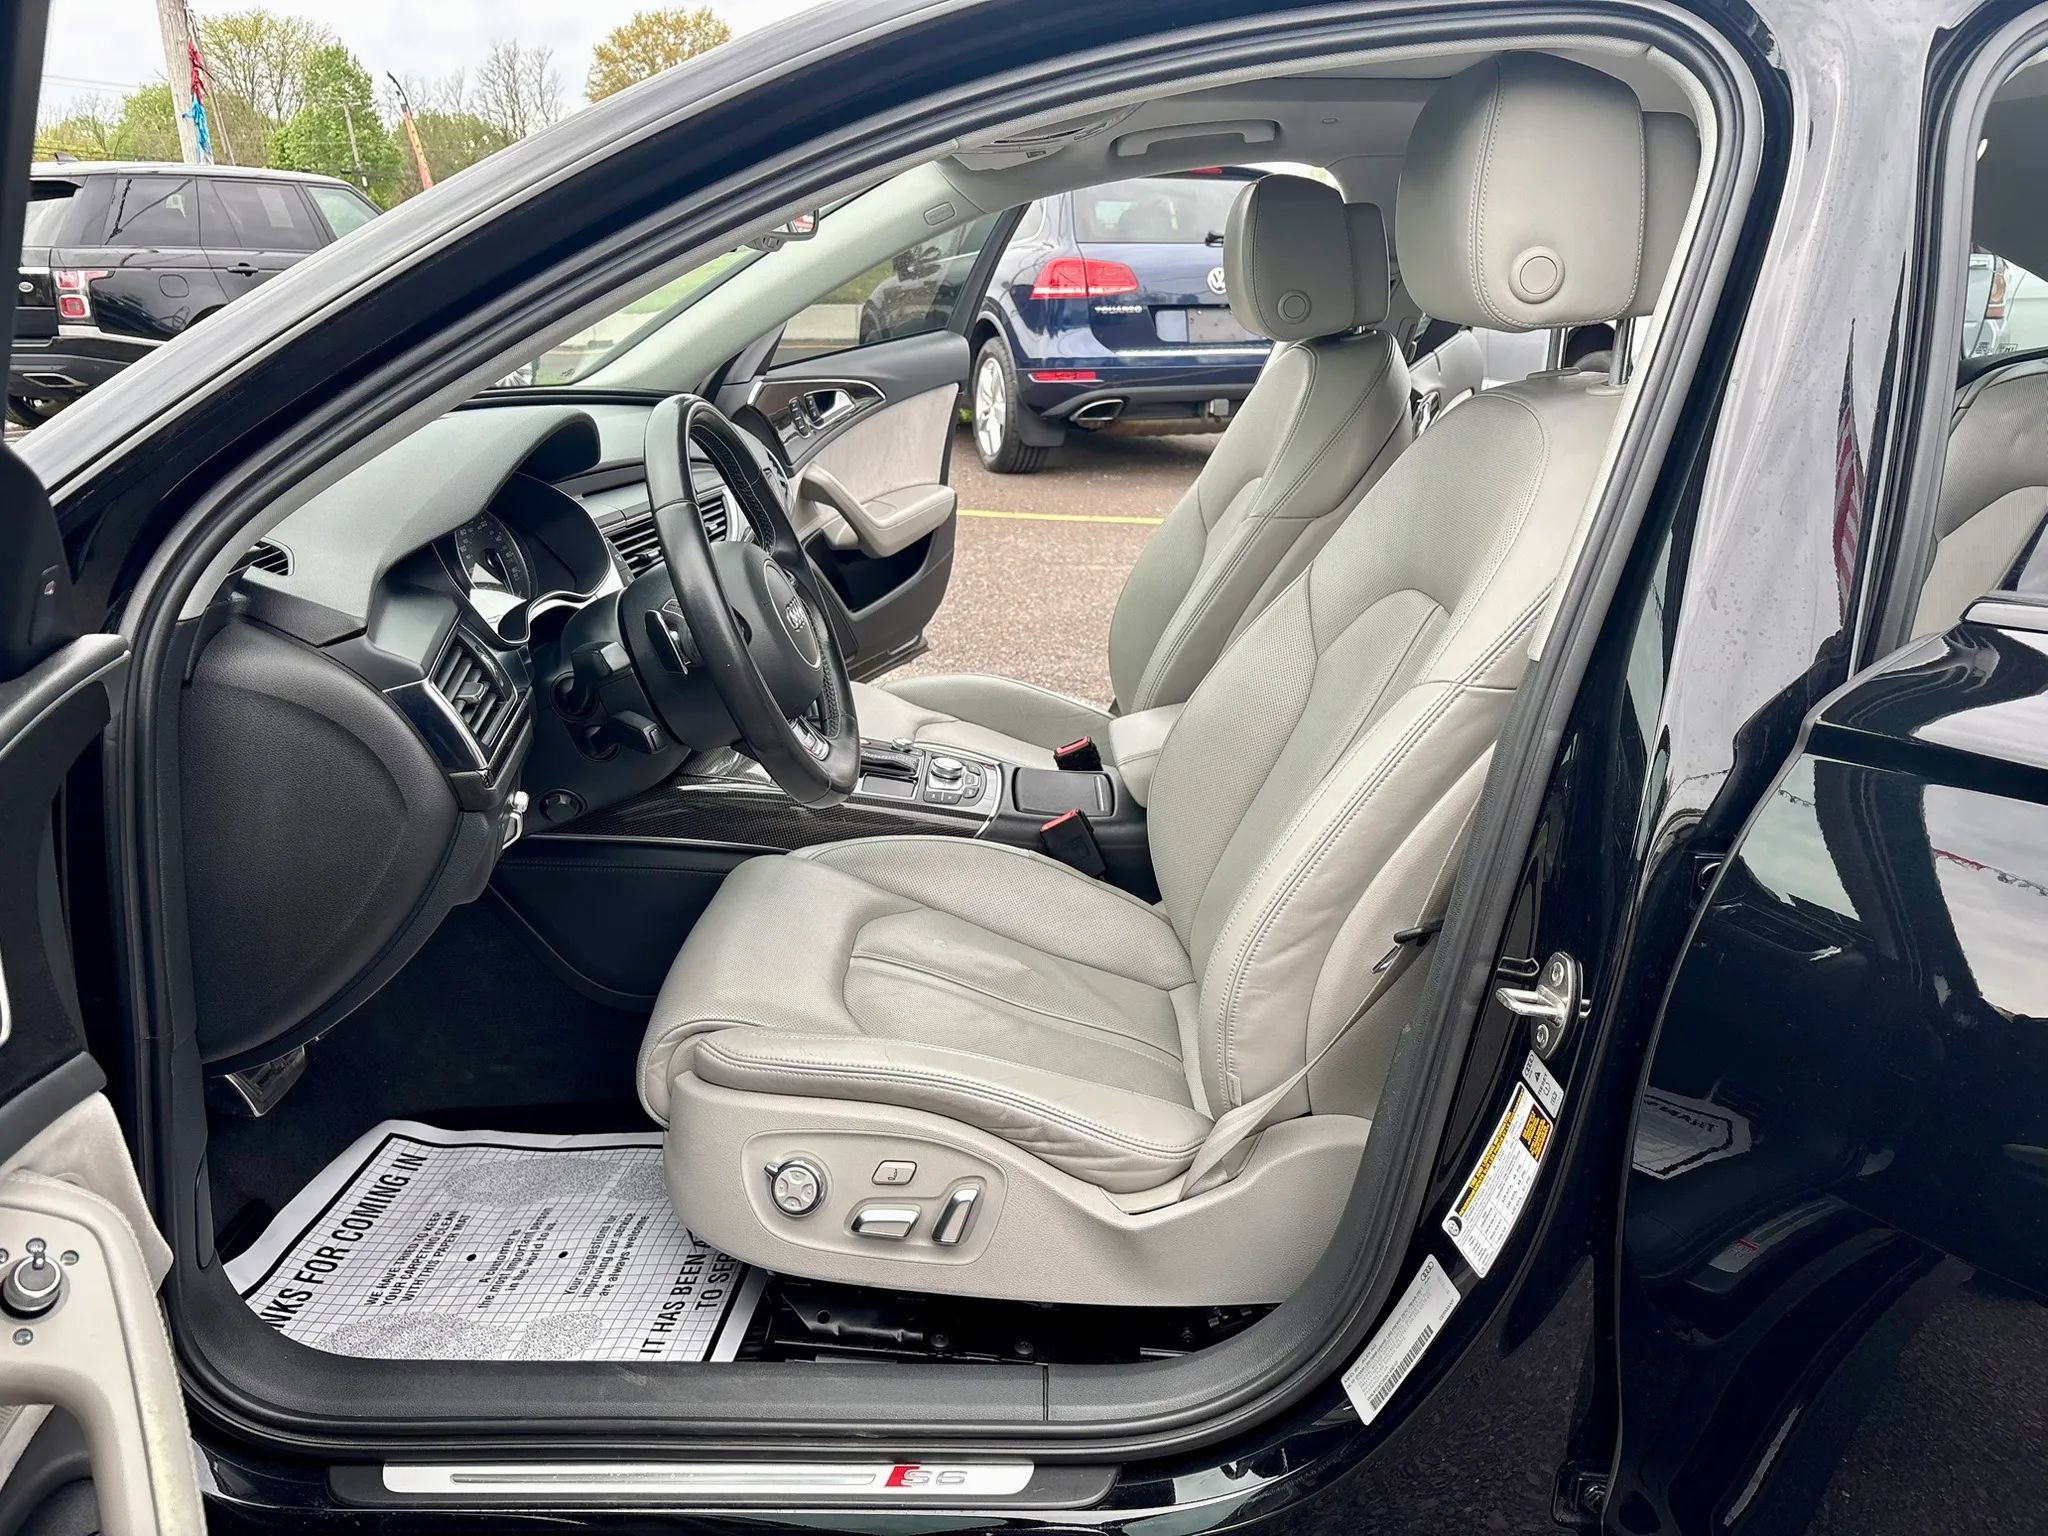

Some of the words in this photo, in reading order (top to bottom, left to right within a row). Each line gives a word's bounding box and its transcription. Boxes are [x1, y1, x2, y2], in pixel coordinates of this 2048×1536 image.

[293, 1246, 350, 1284] FOR
[331, 1173, 410, 1241] COMING
[391, 1152, 428, 1172] IN
[364, 1291, 384, 1305] WE
[376, 1267, 400, 1289] HAVE
[393, 1243, 419, 1266] TRIED
[413, 1233, 428, 1242] TO
[423, 1212, 442, 1232] KEEP
[380, 1282, 406, 1306] YOUR
[400, 1236, 441, 1280] CARPETING
[434, 1210, 459, 1235] CLEAN
[400, 1279, 425, 1302] WITH
[418, 1259, 440, 1277] THIS
[433, 1233, 459, 1257] PAPER
[452, 1214, 471, 1231] MAT
[486, 1238, 515, 1276] customer
[505, 1282, 519, 1291] in
[524, 1243, 544, 1267] world
[537, 1232, 549, 1241] to
[563, 1277, 583, 1295] Your
[578, 1225, 611, 1275] suggestions
[606, 1240, 619, 1255] our
[477, 1295, 494, 1309] the
[489, 1273, 510, 1292] most
[599, 1284, 614, 1296] are
[608, 1251, 630, 1282] always
[670, 1254, 707, 1296] BEEN
[650, 1301, 686, 1333] HAS
[695, 1289, 723, 1310] TO
[640, 1338, 665, 1353] IT
[900, 1469, 968, 1486] S6
